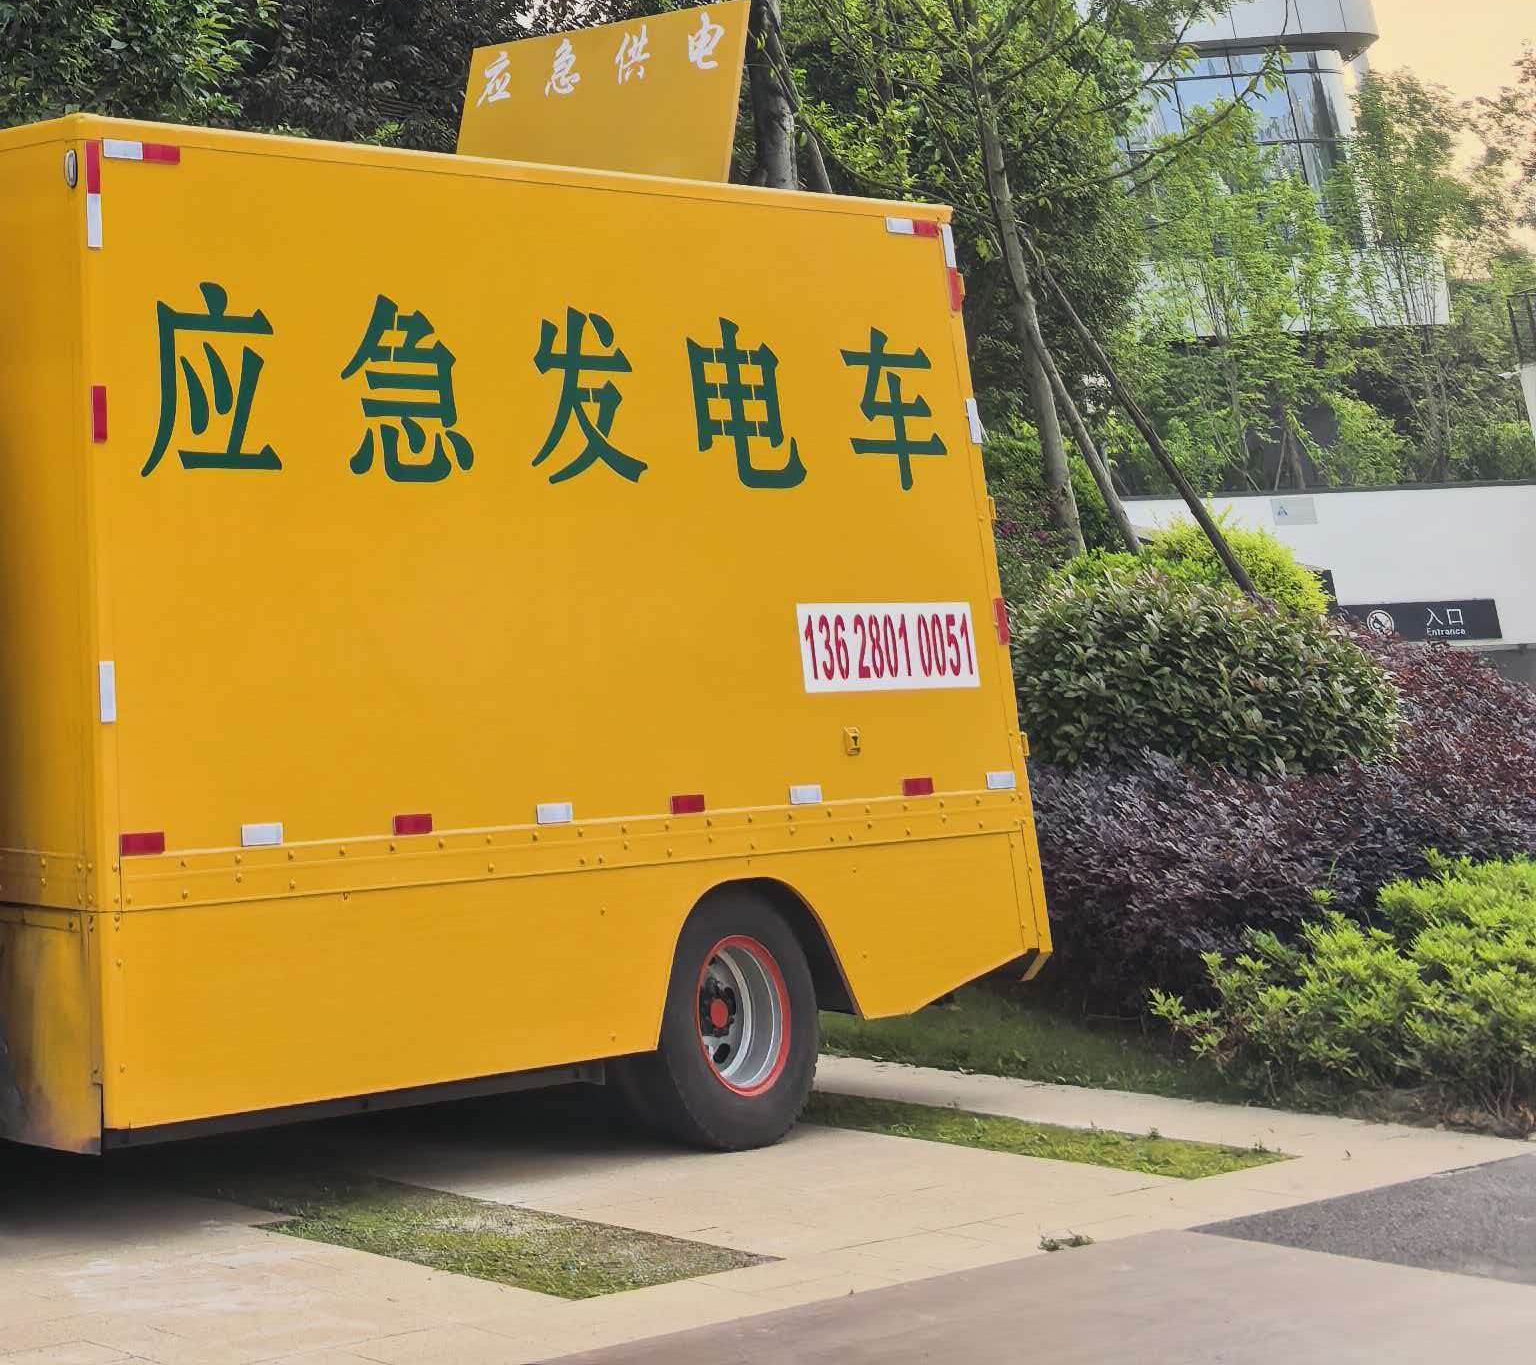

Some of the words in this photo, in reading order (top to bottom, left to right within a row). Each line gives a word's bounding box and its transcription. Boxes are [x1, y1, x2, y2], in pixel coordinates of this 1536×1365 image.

[476, 12, 725, 108] 应急供电
[140, 281, 948, 491] 应急发电车
[1426, 607, 1464, 626] 入口
[1426, 627, 1466, 637] Entrance
